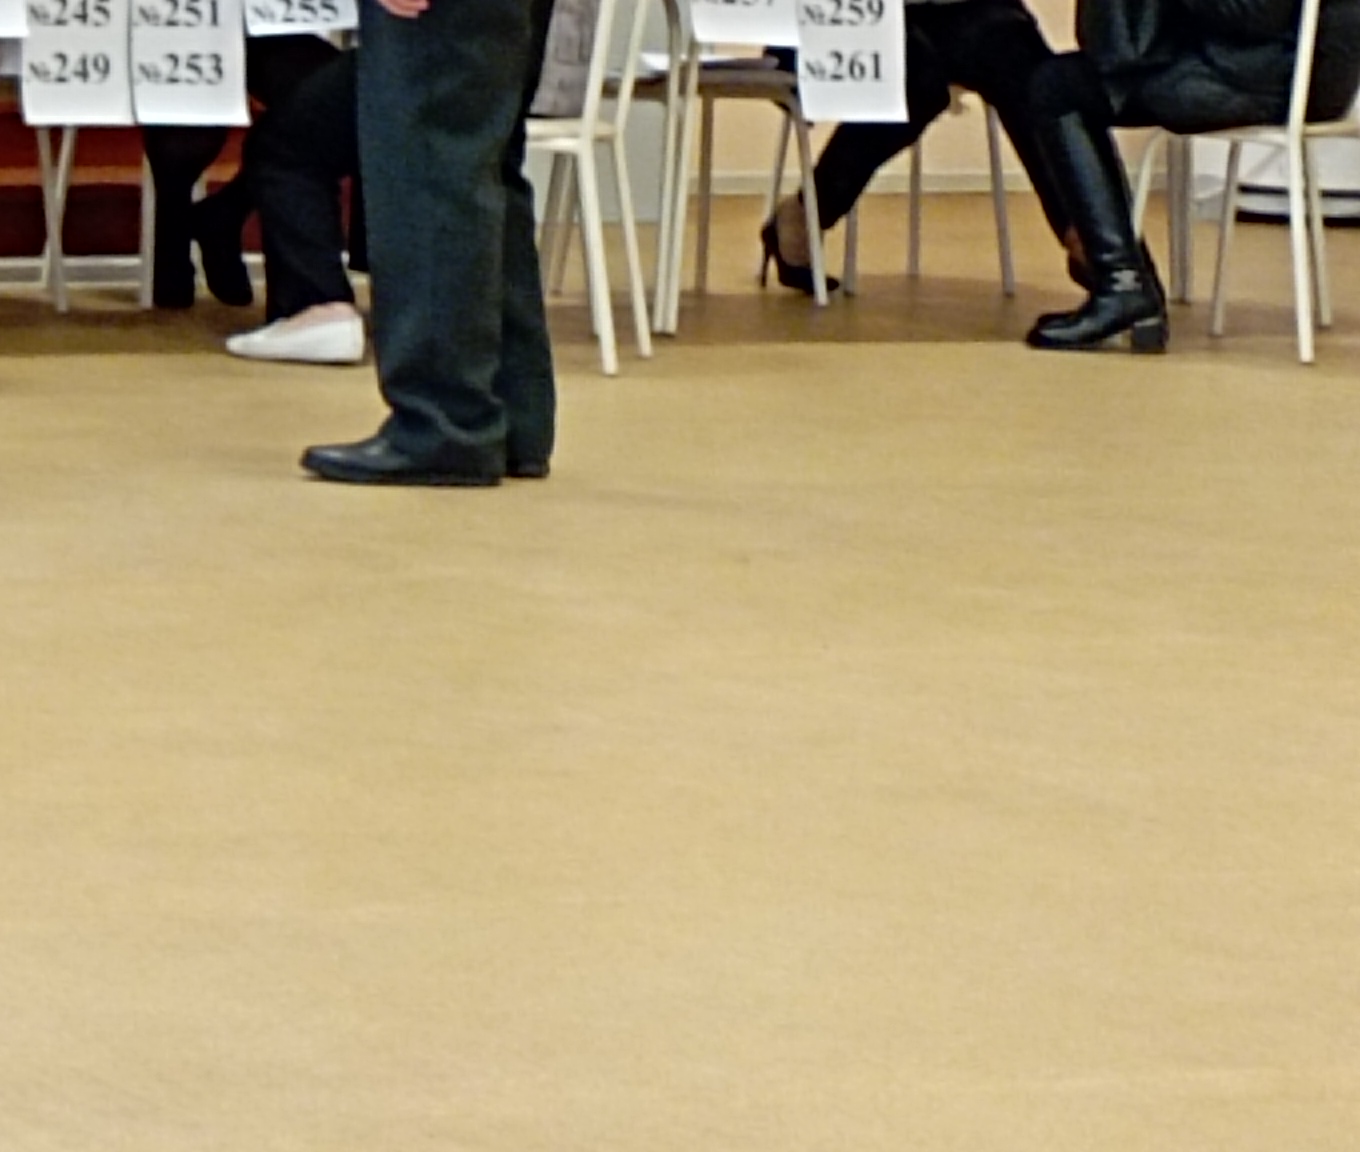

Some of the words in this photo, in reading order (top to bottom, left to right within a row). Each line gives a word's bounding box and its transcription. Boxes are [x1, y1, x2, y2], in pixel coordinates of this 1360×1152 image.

[26, 50, 112, 85] №249
[137, 52, 225, 86] №253
[801, 49, 883, 83] №261
